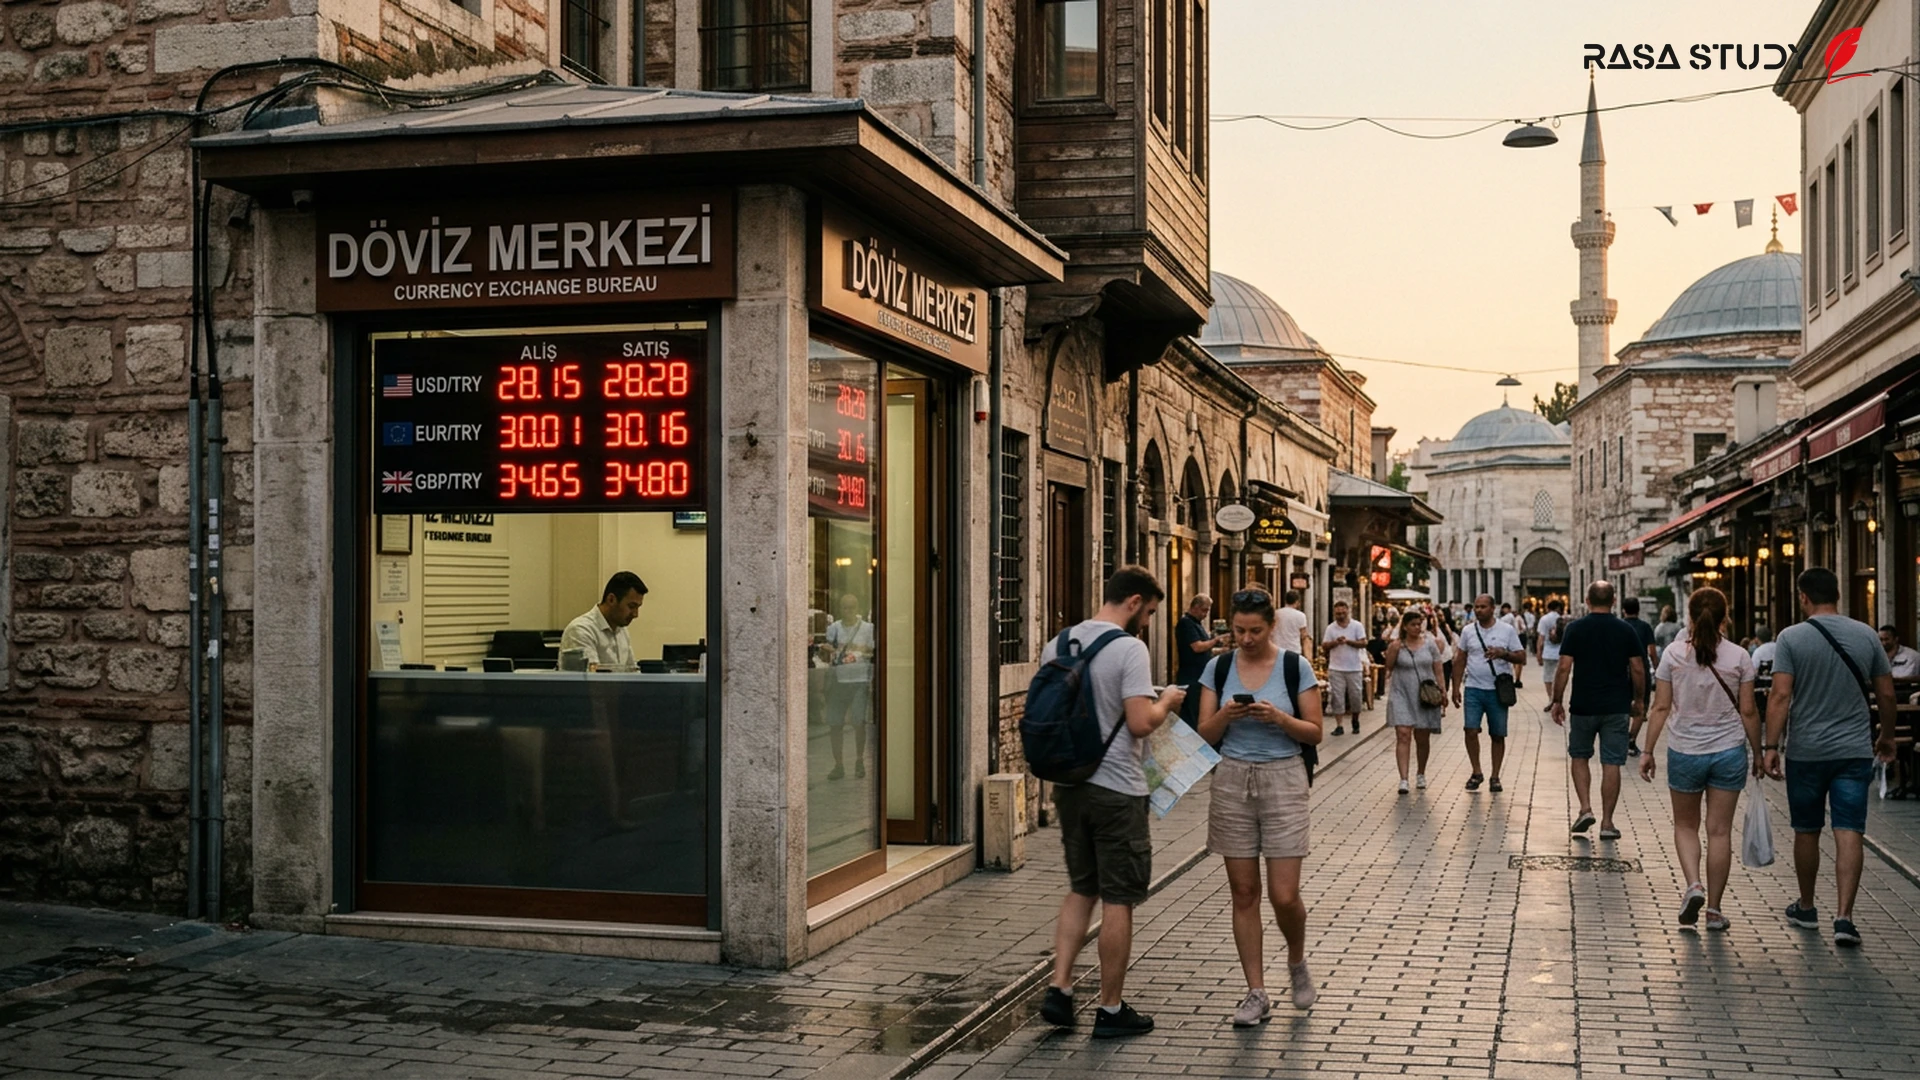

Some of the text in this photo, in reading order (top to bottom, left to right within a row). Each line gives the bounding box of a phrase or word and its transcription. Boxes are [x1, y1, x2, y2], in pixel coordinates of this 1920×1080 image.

[329, 204, 711, 278] DÖVİZ MERKEZİ
[394, 276, 658, 301] CURRENCY EXCHANGE BUREAU
[853, 237, 908, 313] DÖVİZ
[520, 340, 670, 363] ALİŞ SATIŞ
[416, 362, 688, 400] USD/TRY 28.15 28.28
[416, 411, 688, 449] EUR/TRY 30.01 30.16
[415, 461, 688, 498] GBP/TRY 34.65 34.80
